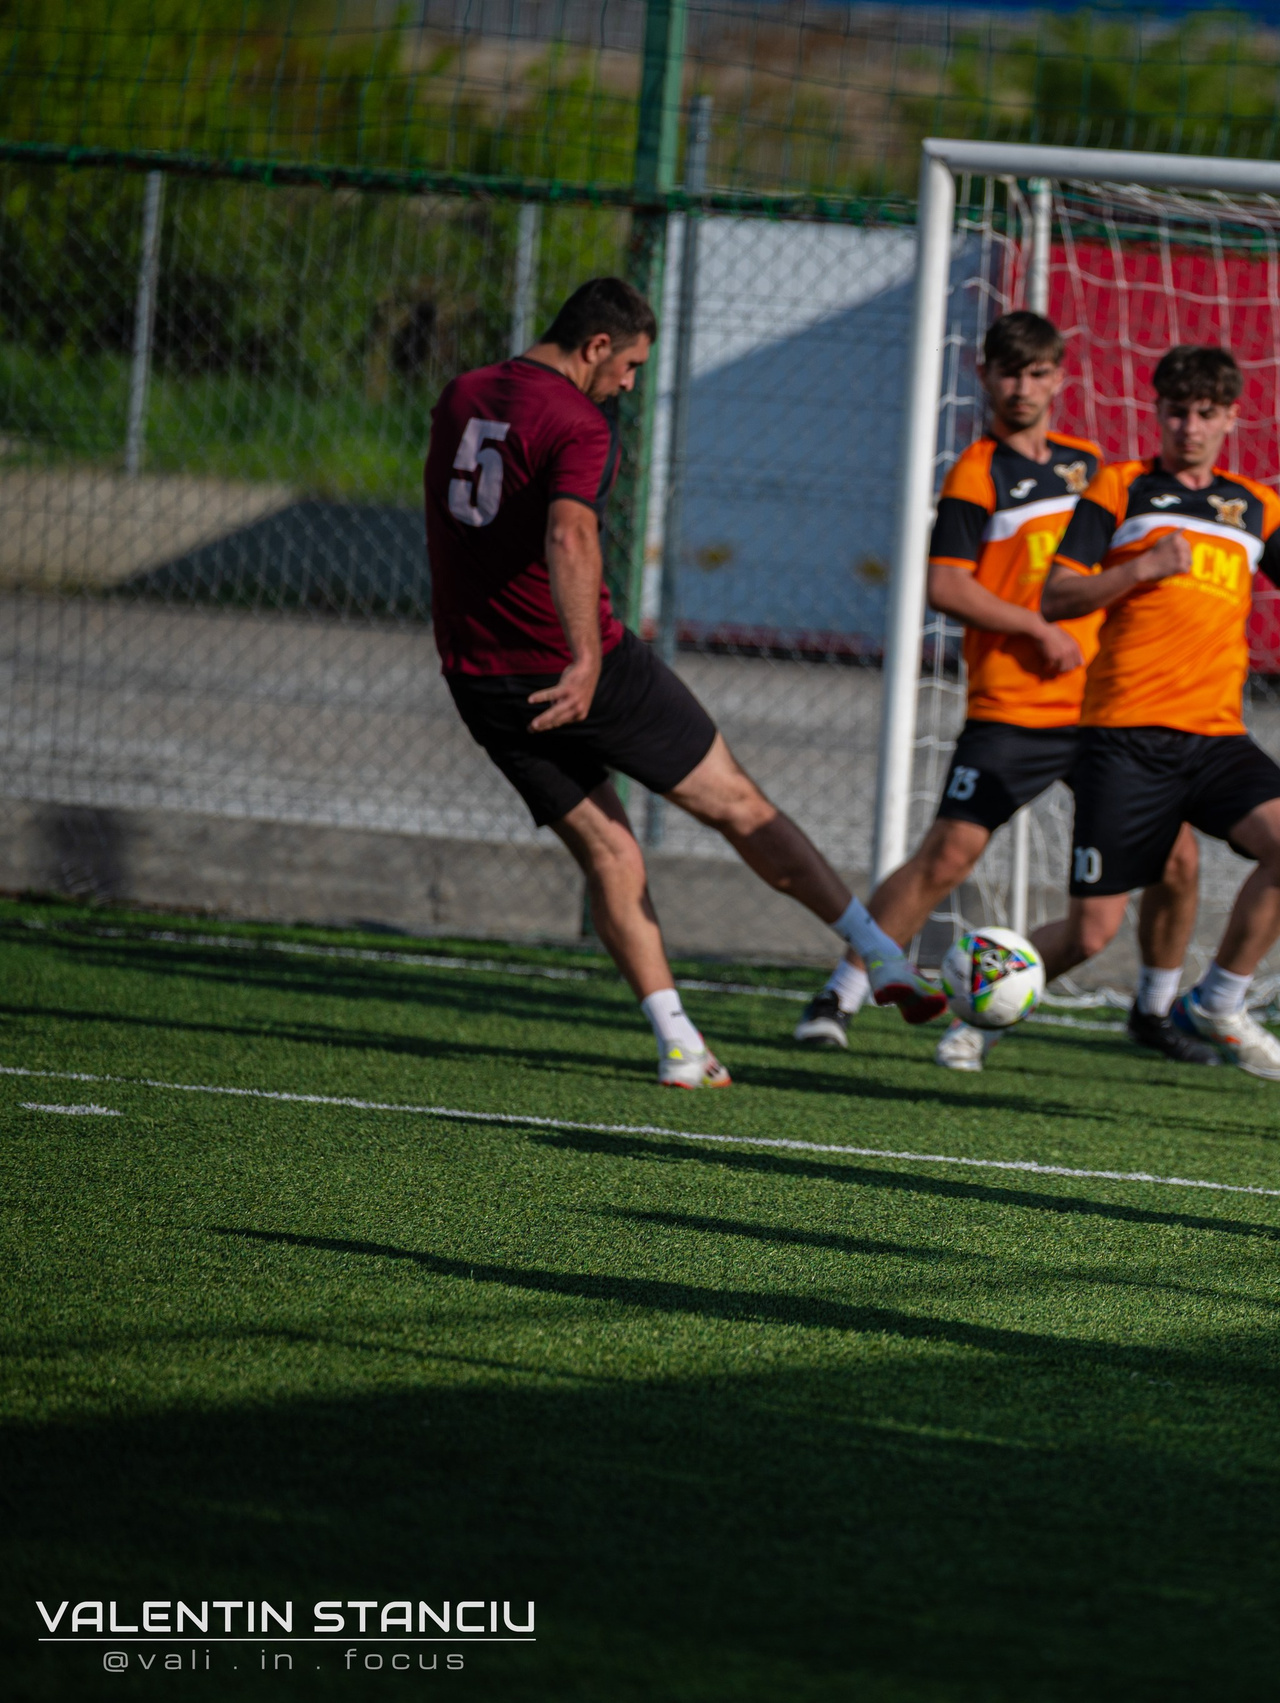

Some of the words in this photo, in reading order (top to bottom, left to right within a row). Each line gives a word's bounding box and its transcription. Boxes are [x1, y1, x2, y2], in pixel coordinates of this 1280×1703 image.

[448, 417, 511, 528] 5
[1191, 541, 1243, 592] CM
[1074, 847, 1103, 884] 10
